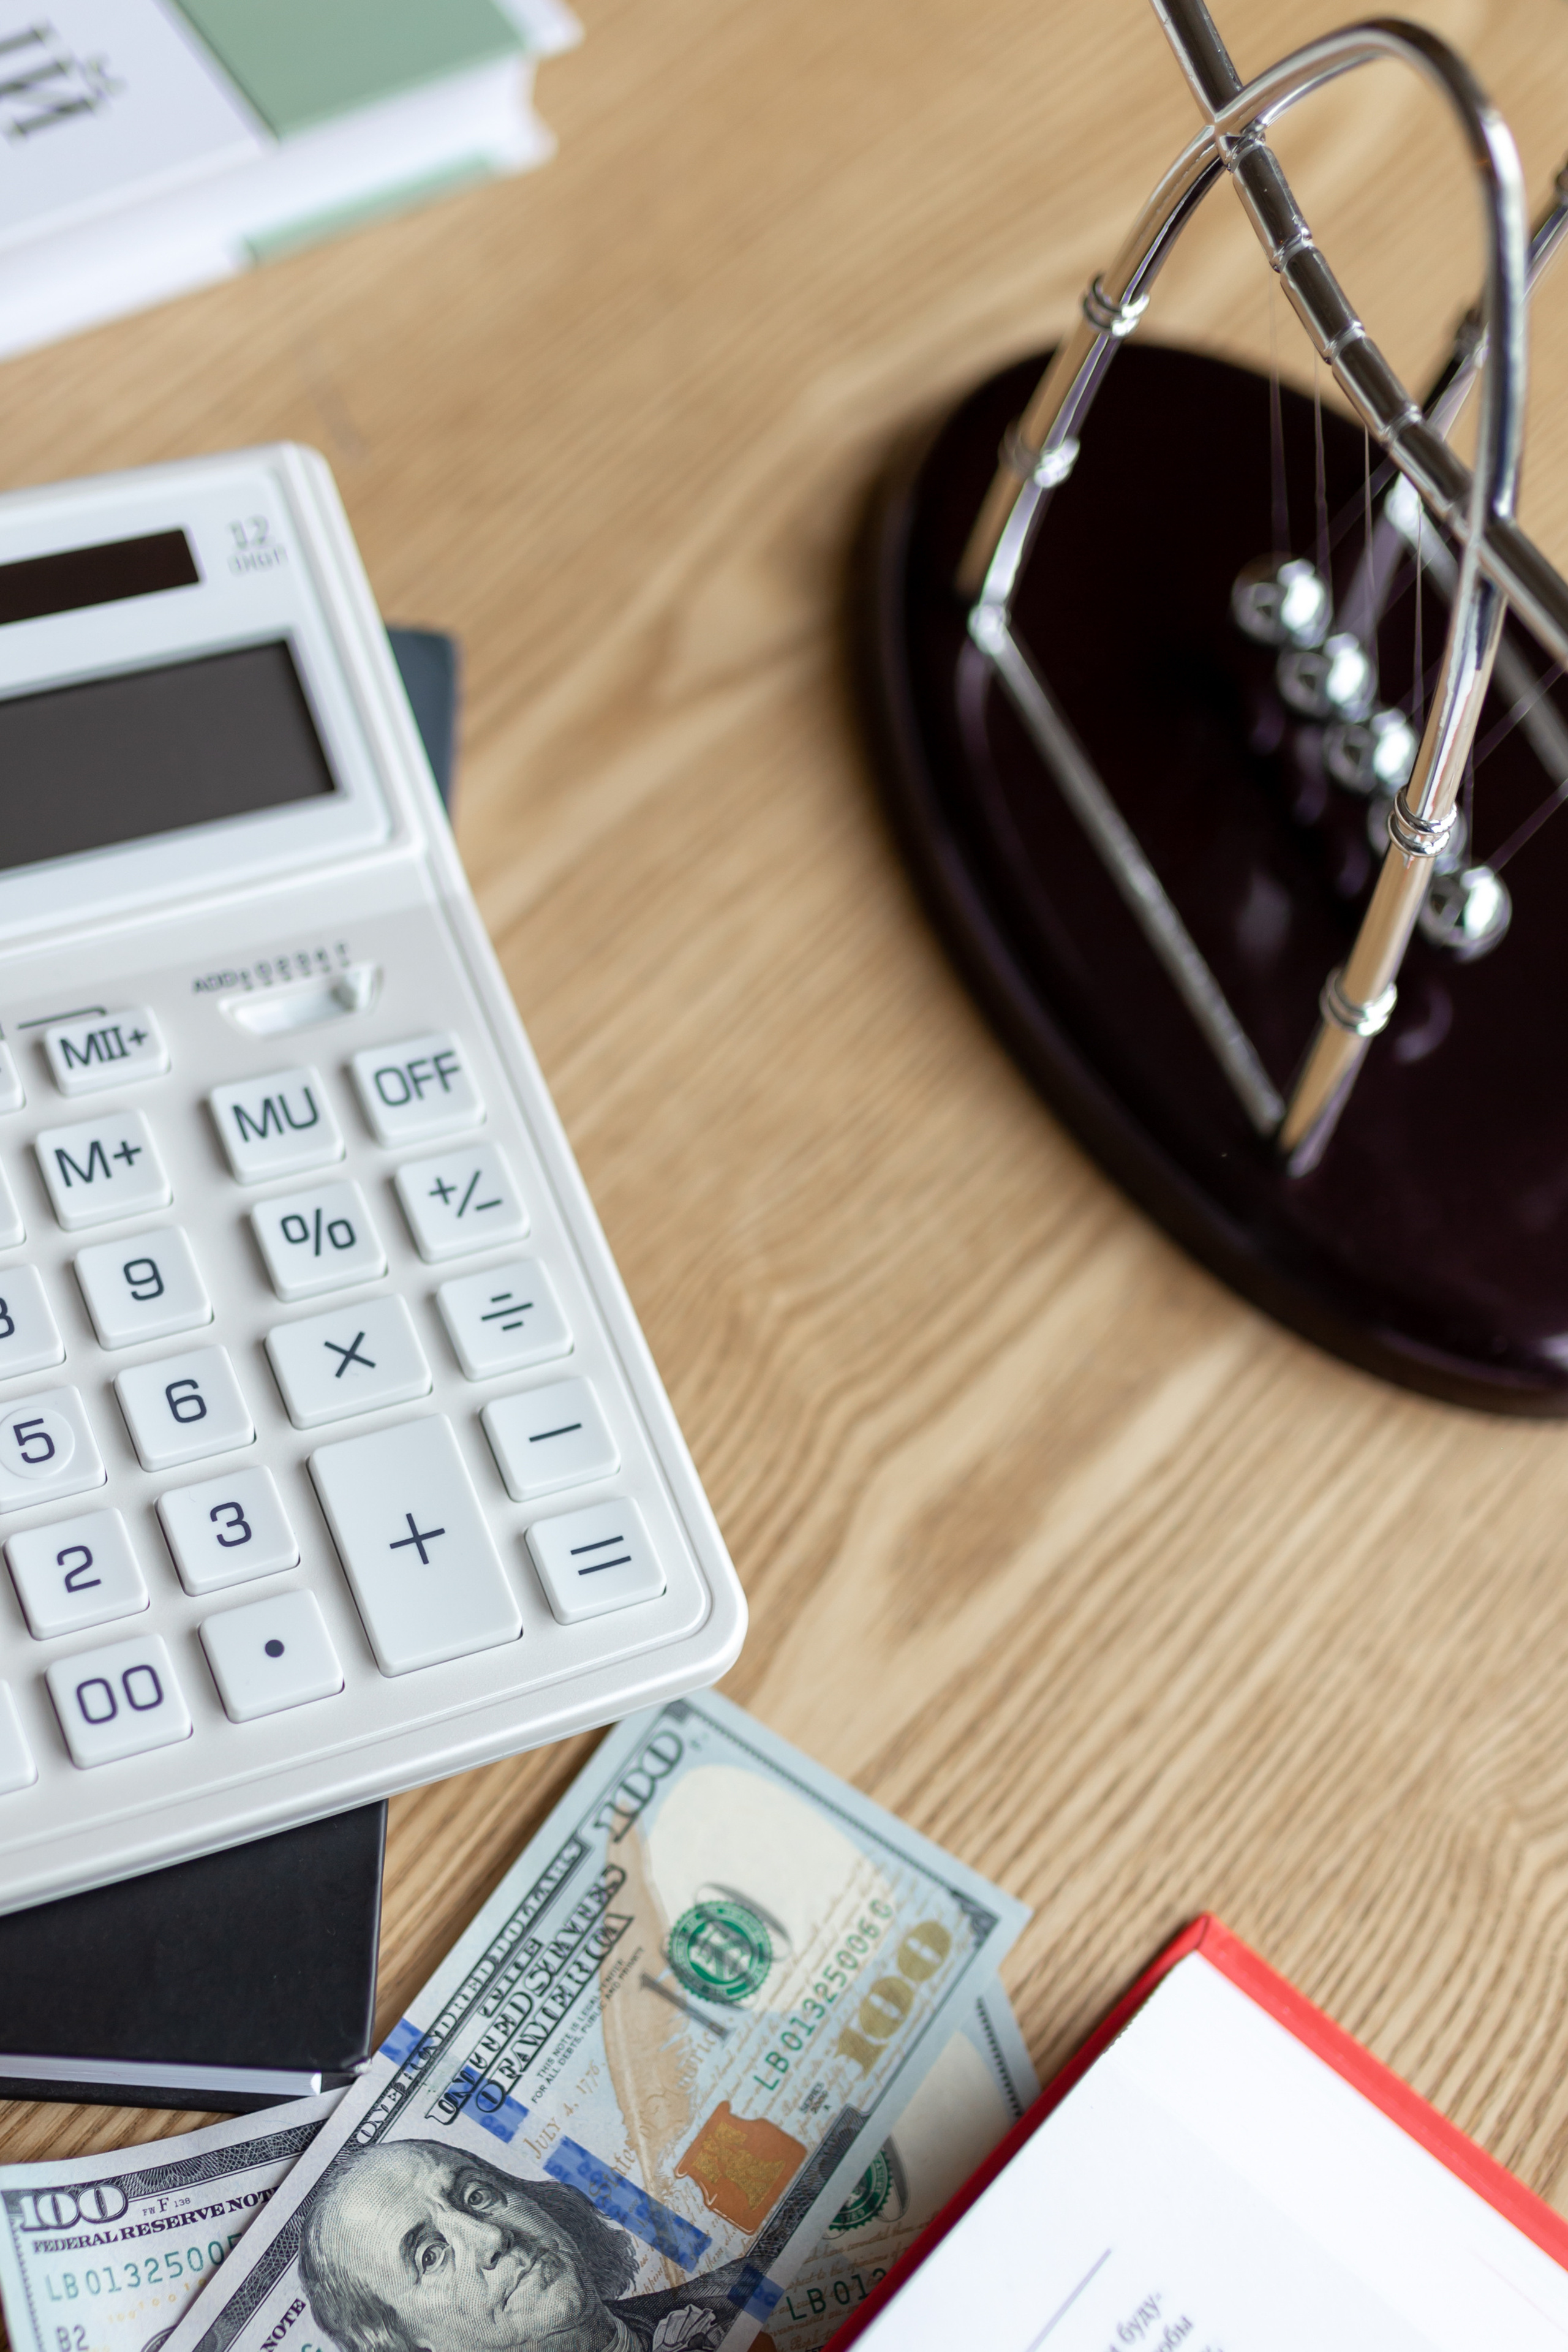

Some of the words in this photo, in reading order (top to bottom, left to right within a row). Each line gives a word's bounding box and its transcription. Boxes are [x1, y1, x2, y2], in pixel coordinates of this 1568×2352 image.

[227, 516, 273, 550] 12
[59, 1027, 148, 1069] MII+
[374, 1051, 461, 1106] OFF
[233, 1087, 318, 1142] MU
[55, 1140, 141, 1188] M+
[281, 1208, 356, 1256] %
[123, 1258, 164, 1301] 9
[165, 1379, 207, 1423] 6
[12, 1417, 56, 1464] 5
[209, 1502, 252, 1547] 3
[390, 1513, 445, 1564] +
[57, 1545, 102, 1592] 2
[570, 1536, 631, 1575] =
[76, 1664, 164, 1724] 00
[424, 1988, 536, 2132] UNITED
[520, 1860, 629, 1999] STATES
[833, 1919, 952, 2082] 100
[536, 2057, 556, 2079] THIS
[552, 2031, 575, 2057] NOTE
[570, 2021, 581, 2033] IS
[530, 2084, 548, 2104] FOR
[543, 2065, 561, 2084] ALL
[353, 2084, 404, 2147] ONE
[20, 2184, 129, 2232] 100
[174, 2196, 191, 2207] 138
[33, 2225, 119, 2254] FEDERAL
[120, 2202, 225, 2241] RESERVE
[260, 2298, 306, 2352] NOTE
